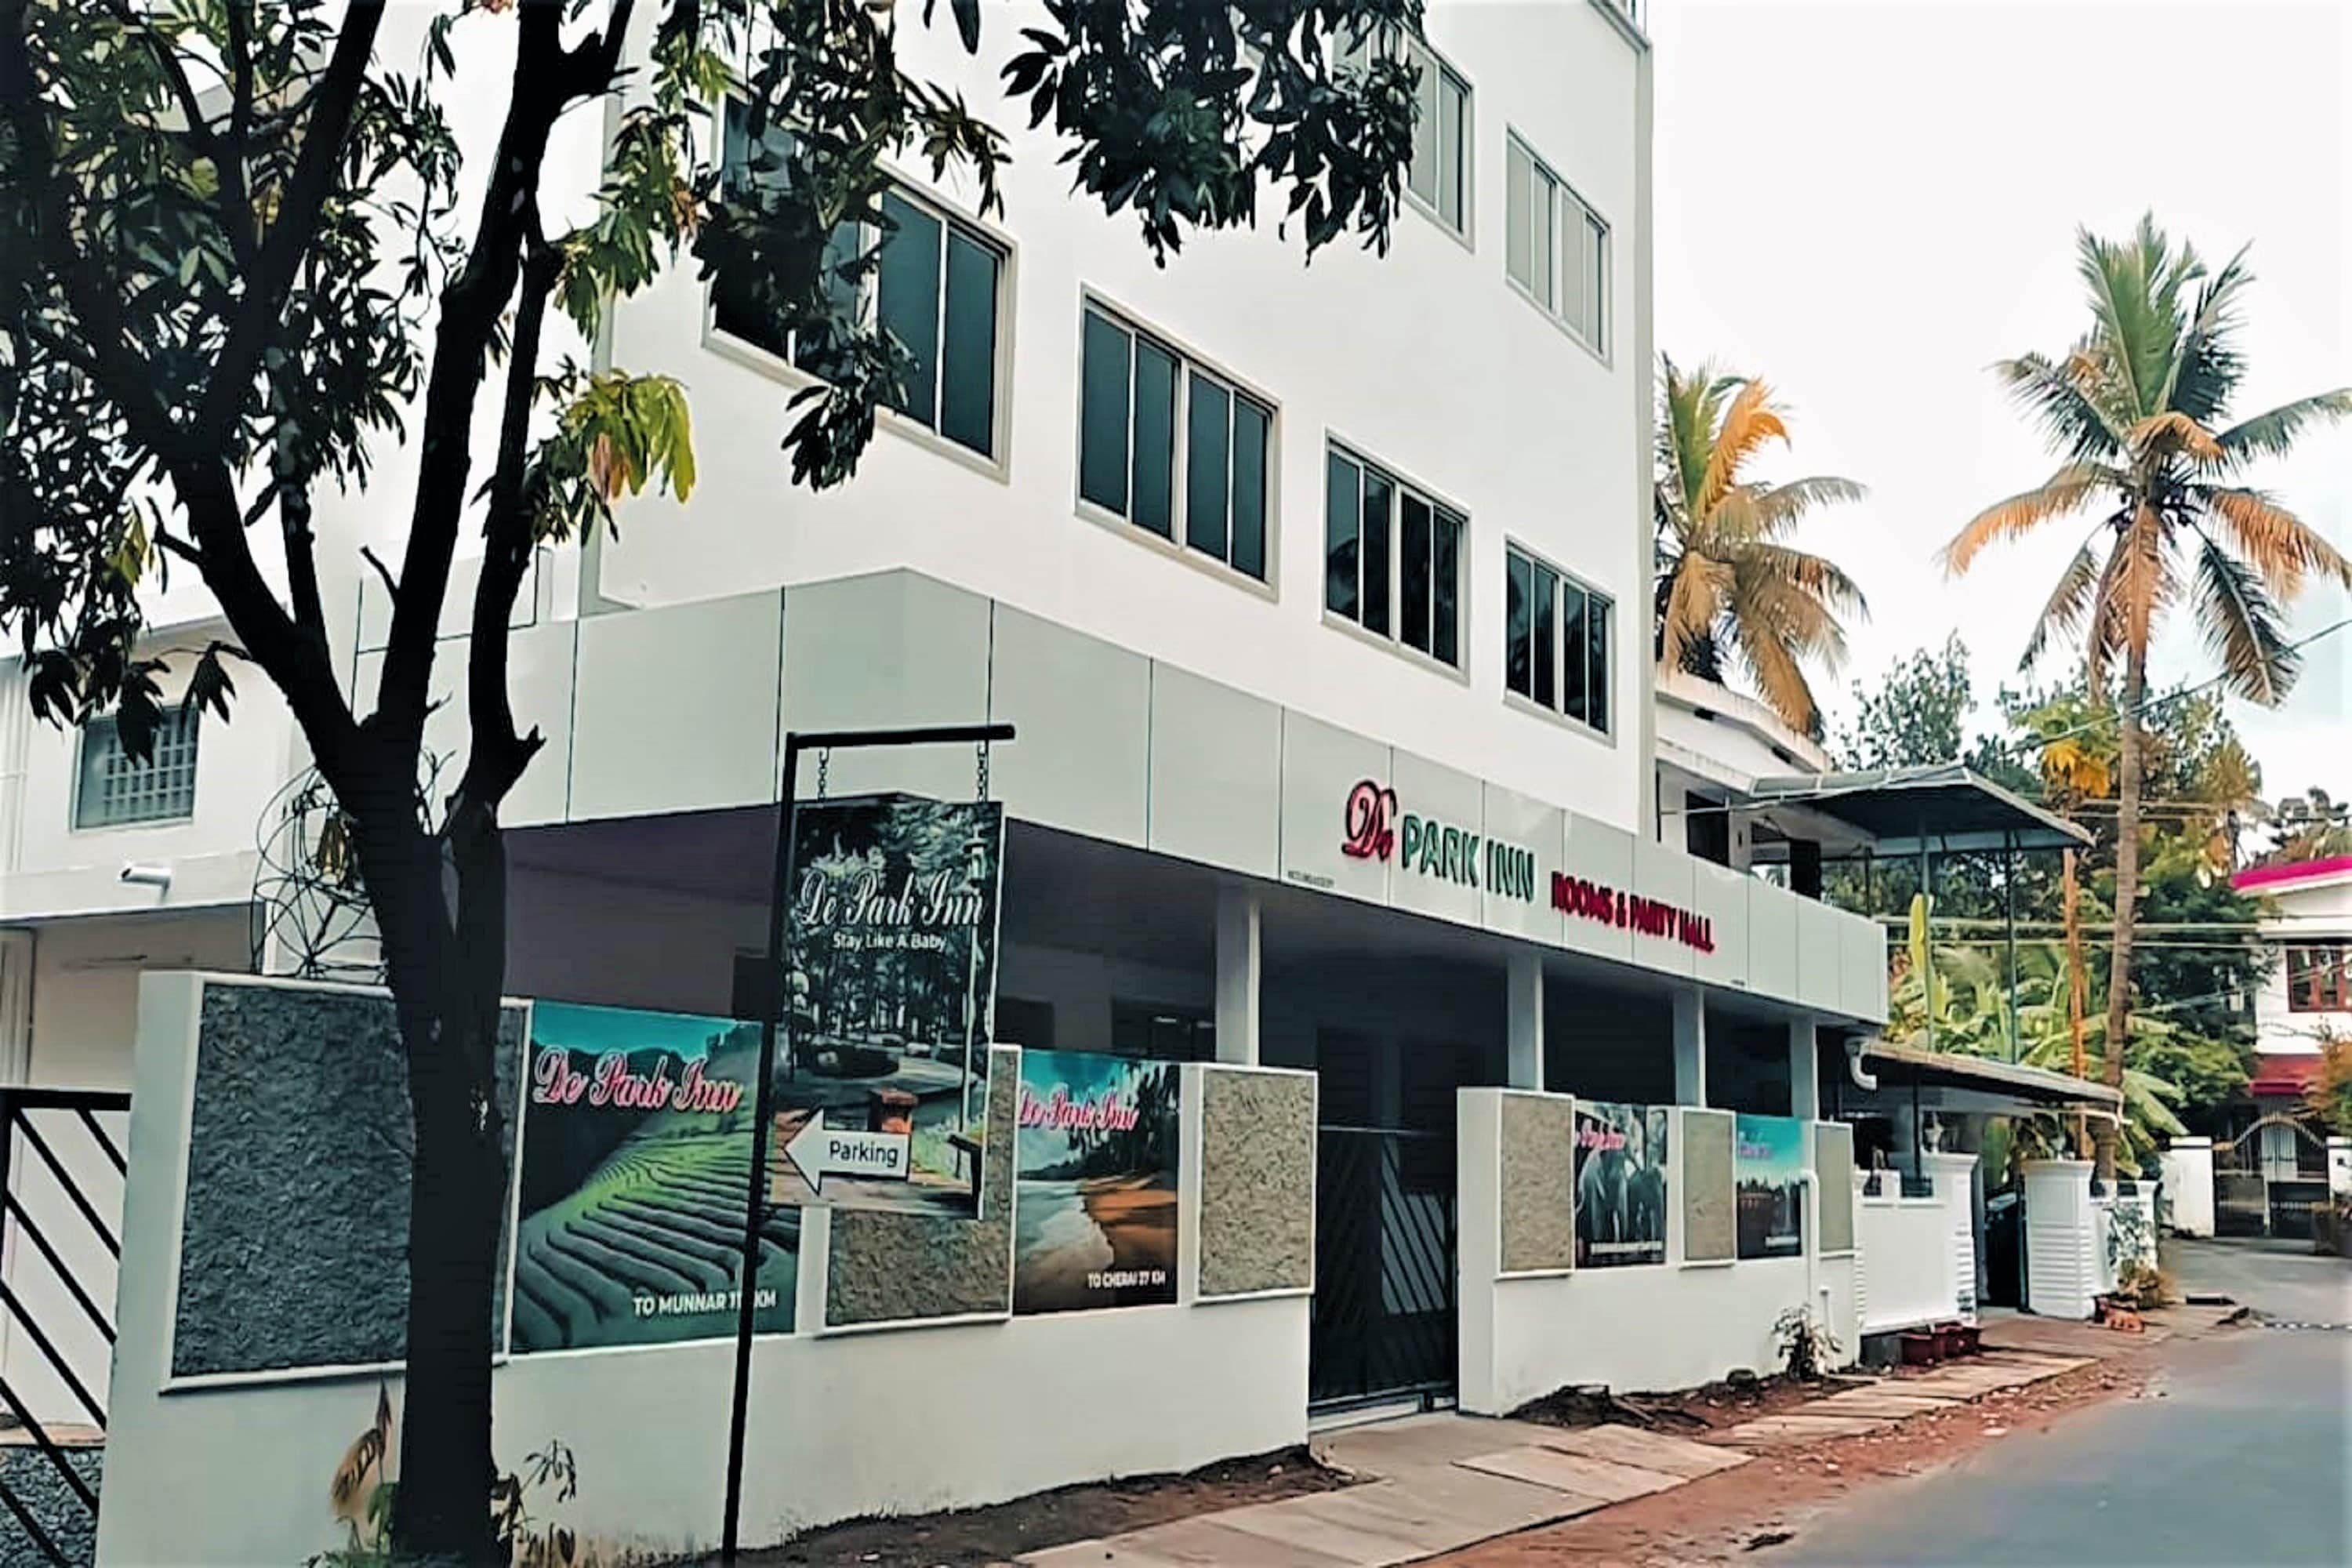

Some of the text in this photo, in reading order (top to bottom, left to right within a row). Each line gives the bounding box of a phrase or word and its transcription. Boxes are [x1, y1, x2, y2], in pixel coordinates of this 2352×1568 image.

[1402, 814, 1479, 887] PARK
[1487, 838, 1534, 903] INN
[800, 867, 984, 925] De Park Inn
[1552, 871, 1715, 953] ROOMS & PARTY HALL
[833, 931, 947, 953] Stay Like A Baby
[532, 1045, 743, 1111] De Park Inn
[829, 1140, 898, 1168] Parking
[1087, 1272, 1102, 1289] TO
[633, 1297, 655, 1316] TO
[659, 1293, 725, 1315] MUNNAR
[729, 1290, 745, 1310] 11
